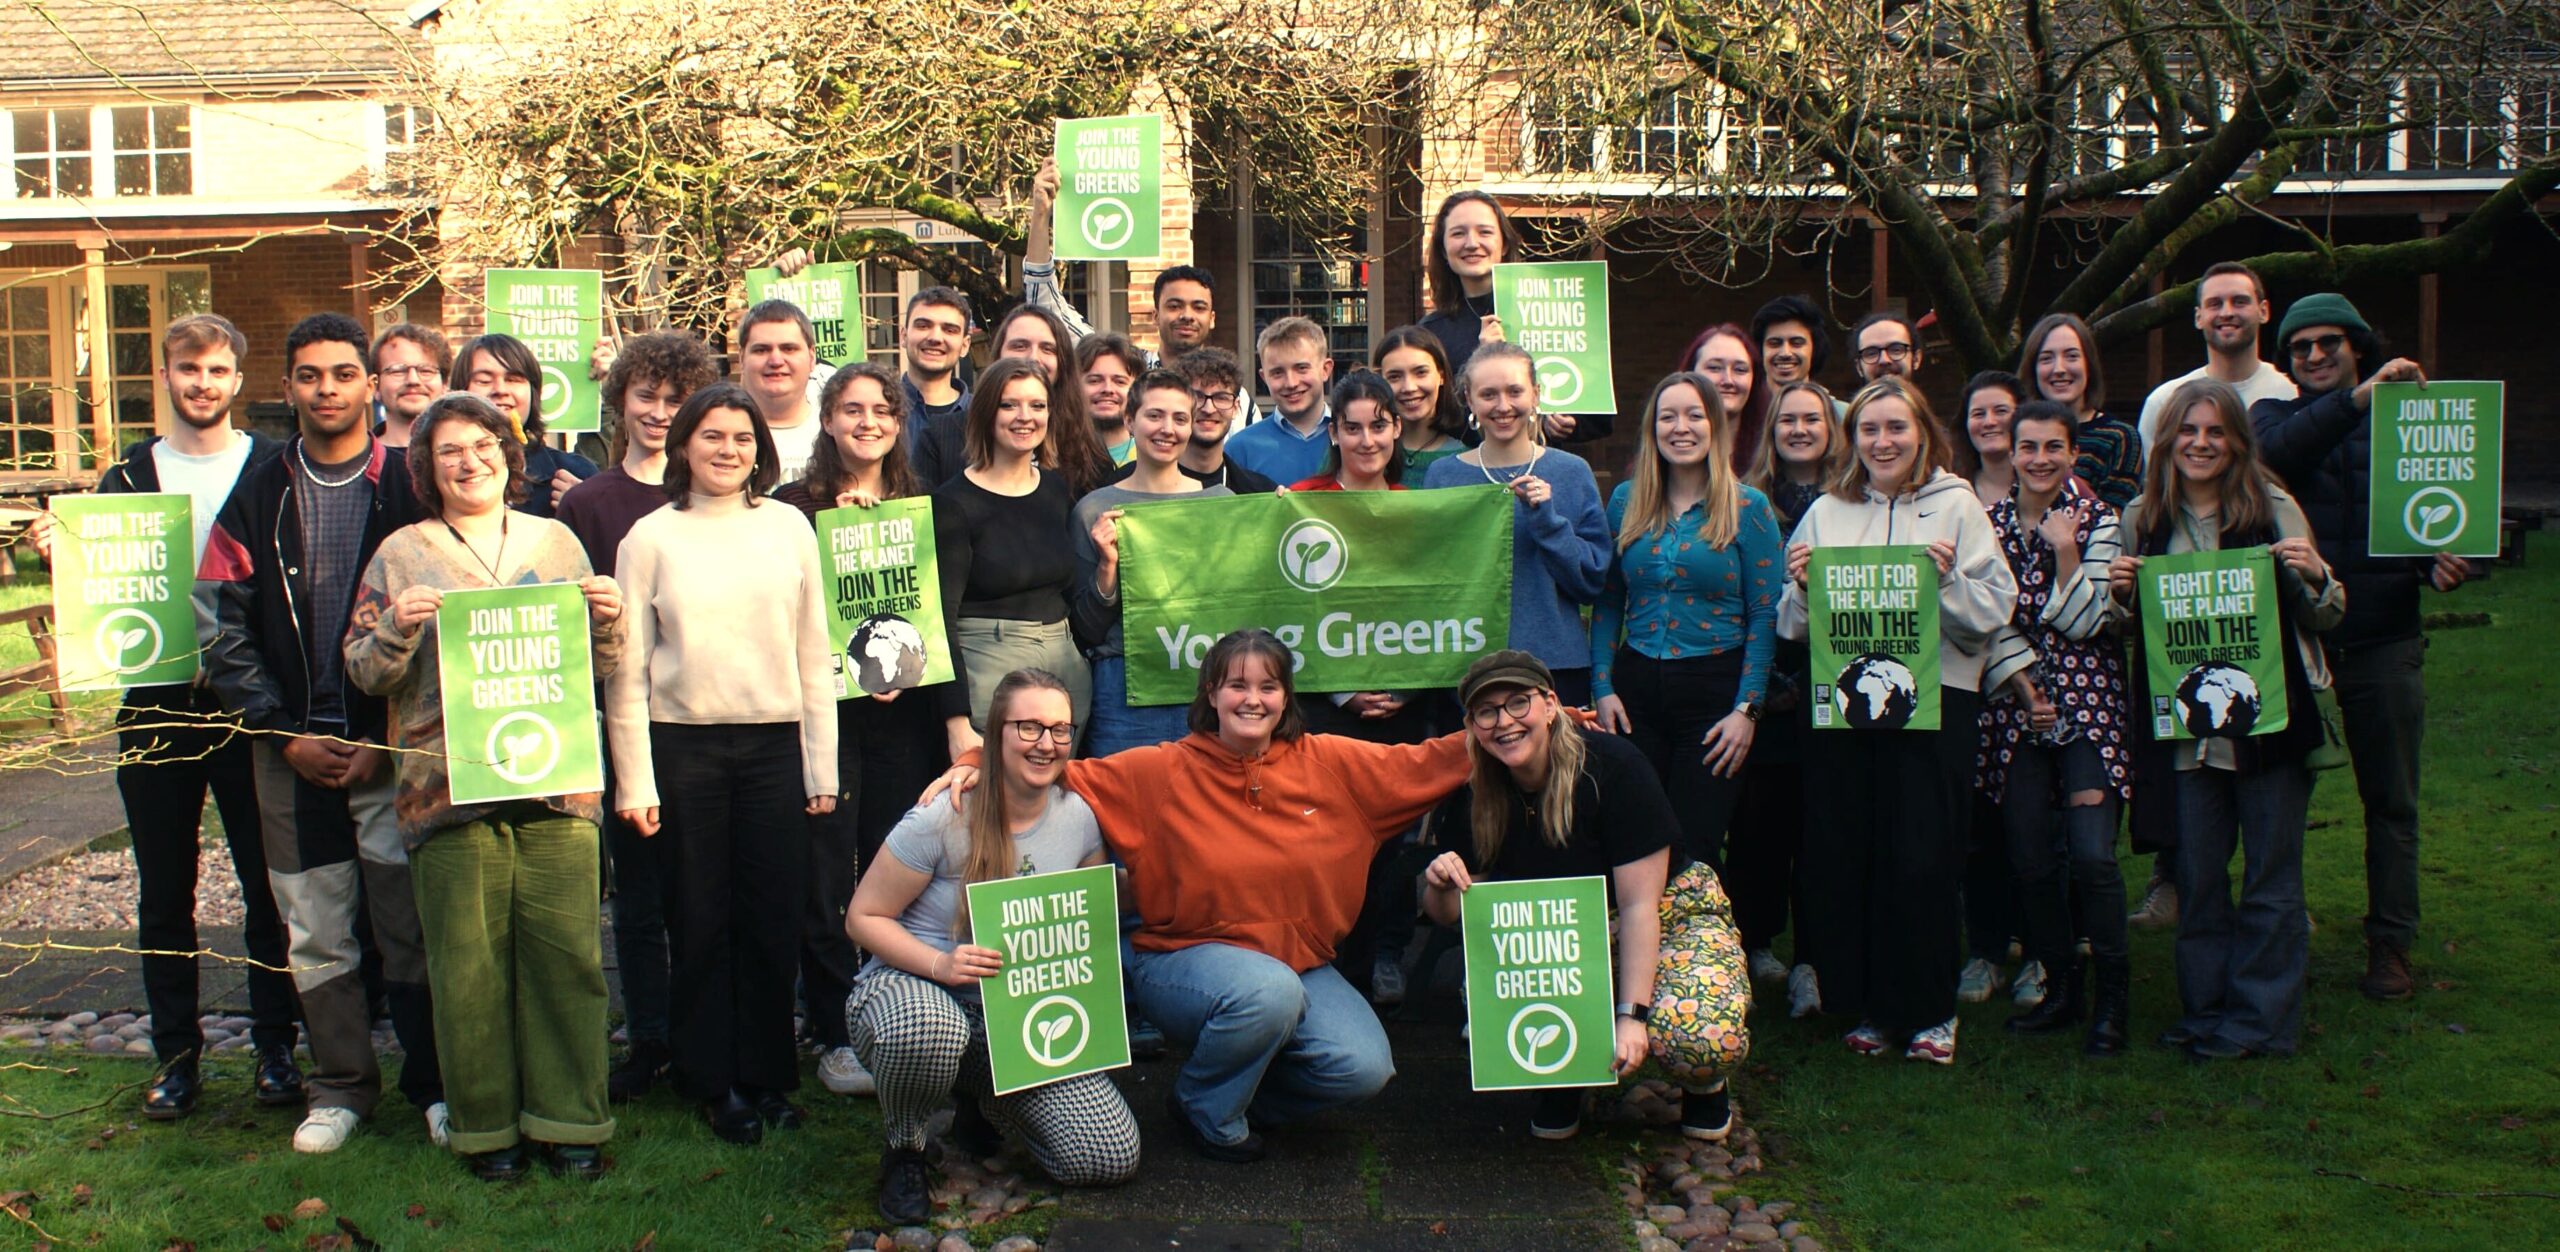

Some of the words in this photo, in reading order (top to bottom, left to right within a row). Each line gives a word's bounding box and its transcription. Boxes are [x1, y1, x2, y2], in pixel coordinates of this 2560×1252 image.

[1076, 128, 1108, 146] JOIN
[1112, 128, 1140, 145] THE
[1075, 146, 1140, 170] YOUNG
[1075, 172, 1140, 194] GREENS
[508, 284, 544, 306] JOIN
[546, 285, 579, 306] THE
[763, 281, 807, 303] FIGHT
[811, 279, 842, 301] FOR
[1516, 278, 1550, 298] JOIN
[1553, 277, 1585, 298] THE
[508, 308, 579, 336] YOUNG
[1517, 301, 1586, 327] YOUNG
[812, 319, 846, 343] THE
[1519, 329, 1587, 352] GREENS
[815, 344, 847, 359] REENS
[2397, 399, 2436, 421] JOIN
[2440, 399, 2476, 420] THE
[2397, 424, 2476, 453] YOUNG
[2397, 457, 2476, 482] GREENS
[80, 512, 122, 538] JOIN
[125, 512, 167, 536] THE
[832, 523, 874, 553] FIGHT
[879, 518, 915, 546] FOR
[81, 540, 167, 574] YOUNG
[833, 552, 859, 575] THE
[860, 544, 916, 570] PLANET
[83, 576, 169, 605] GREENS
[837, 572, 876, 604] JOIN
[879, 566, 920, 596] THE
[1826, 564, 1878, 589] FIGHT
[1882, 564, 1918, 588] FOR
[2158, 571, 2213, 598] FIGHT
[2216, 567, 2256, 593] FOR
[838, 601, 875, 622] YOUNG
[877, 594, 922, 614] GREENS
[1827, 591, 1857, 610] THE
[1860, 590, 1918, 609] PLANET
[2161, 599, 2192, 619] THE
[2195, 594, 2256, 616] PLANET
[467, 606, 513, 636] JOIN
[516, 603, 559, 632] THE
[1829, 611, 1873, 637] JOIN
[1879, 611, 1920, 637] THE
[2165, 619, 2210, 648] JOIN
[2215, 616, 2259, 644] THE
[468, 635, 561, 675] YOUNG
[1156, 624, 1304, 674] Yog
[1317, 612, 1487, 658] Greens
[1831, 640, 1870, 655] YOUNG
[1873, 639, 1920, 654] GREENS
[2167, 648, 2208, 666] YOUNG
[2211, 644, 2260, 661] GREENS
[472, 673, 564, 710] GREENS
[1001, 896, 1045, 928] JOIN
[1048, 889, 1088, 919] THE
[1490, 901, 1534, 928] JOIN
[1537, 898, 1578, 925] THE
[1003, 920, 1090, 964] YOUNG
[1491, 929, 1580, 966] YOUNG
[1007, 956, 1093, 998] GREENS
[1495, 967, 1583, 999] GREENS
